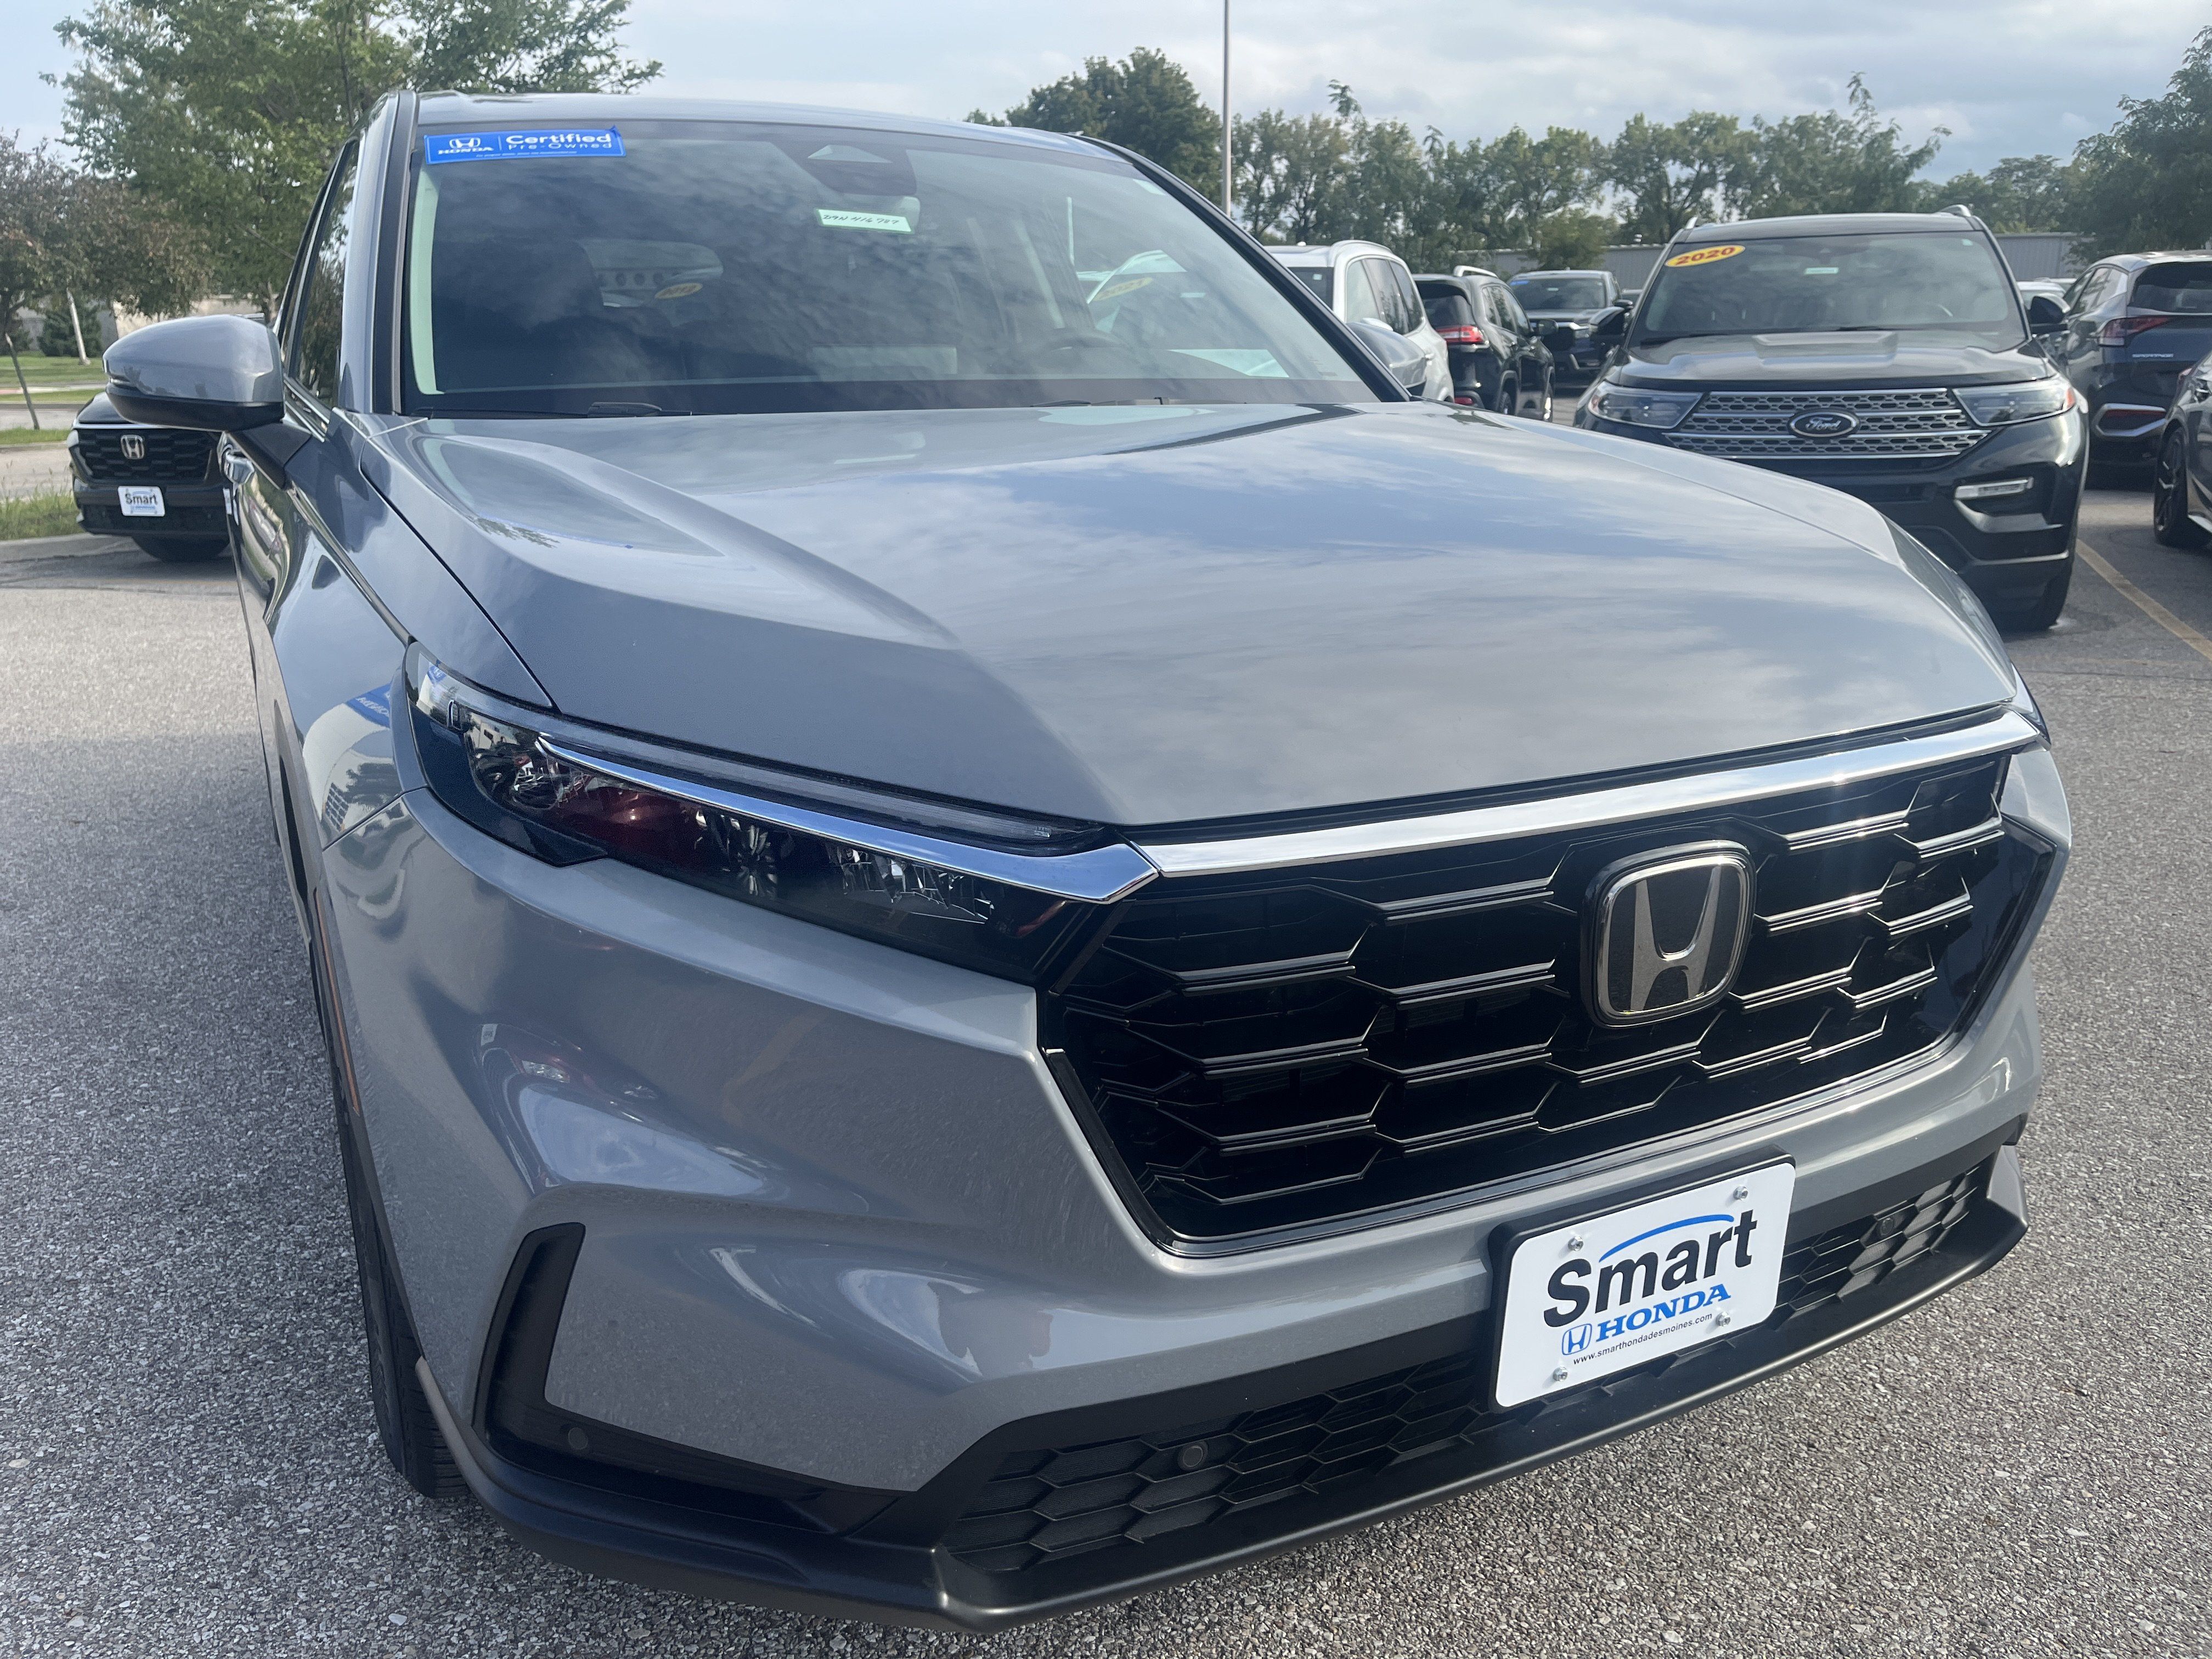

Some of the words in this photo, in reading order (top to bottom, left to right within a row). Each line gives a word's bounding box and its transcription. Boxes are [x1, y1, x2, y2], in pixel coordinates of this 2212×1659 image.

[505, 133, 612, 144] Certified
[508, 142, 612, 150] Pre-Owned
[437, 146, 494, 155] HONDA
[1675, 246, 1735, 266] 2020
[1805, 416, 1842, 431] Ford
[125, 493, 158, 505] Smart
[1543, 1209, 1758, 1328] Smart
[1595, 1284, 1731, 1342] HONDA
[1573, 1312, 1712, 1365] www.smarthondadesmoines.com
